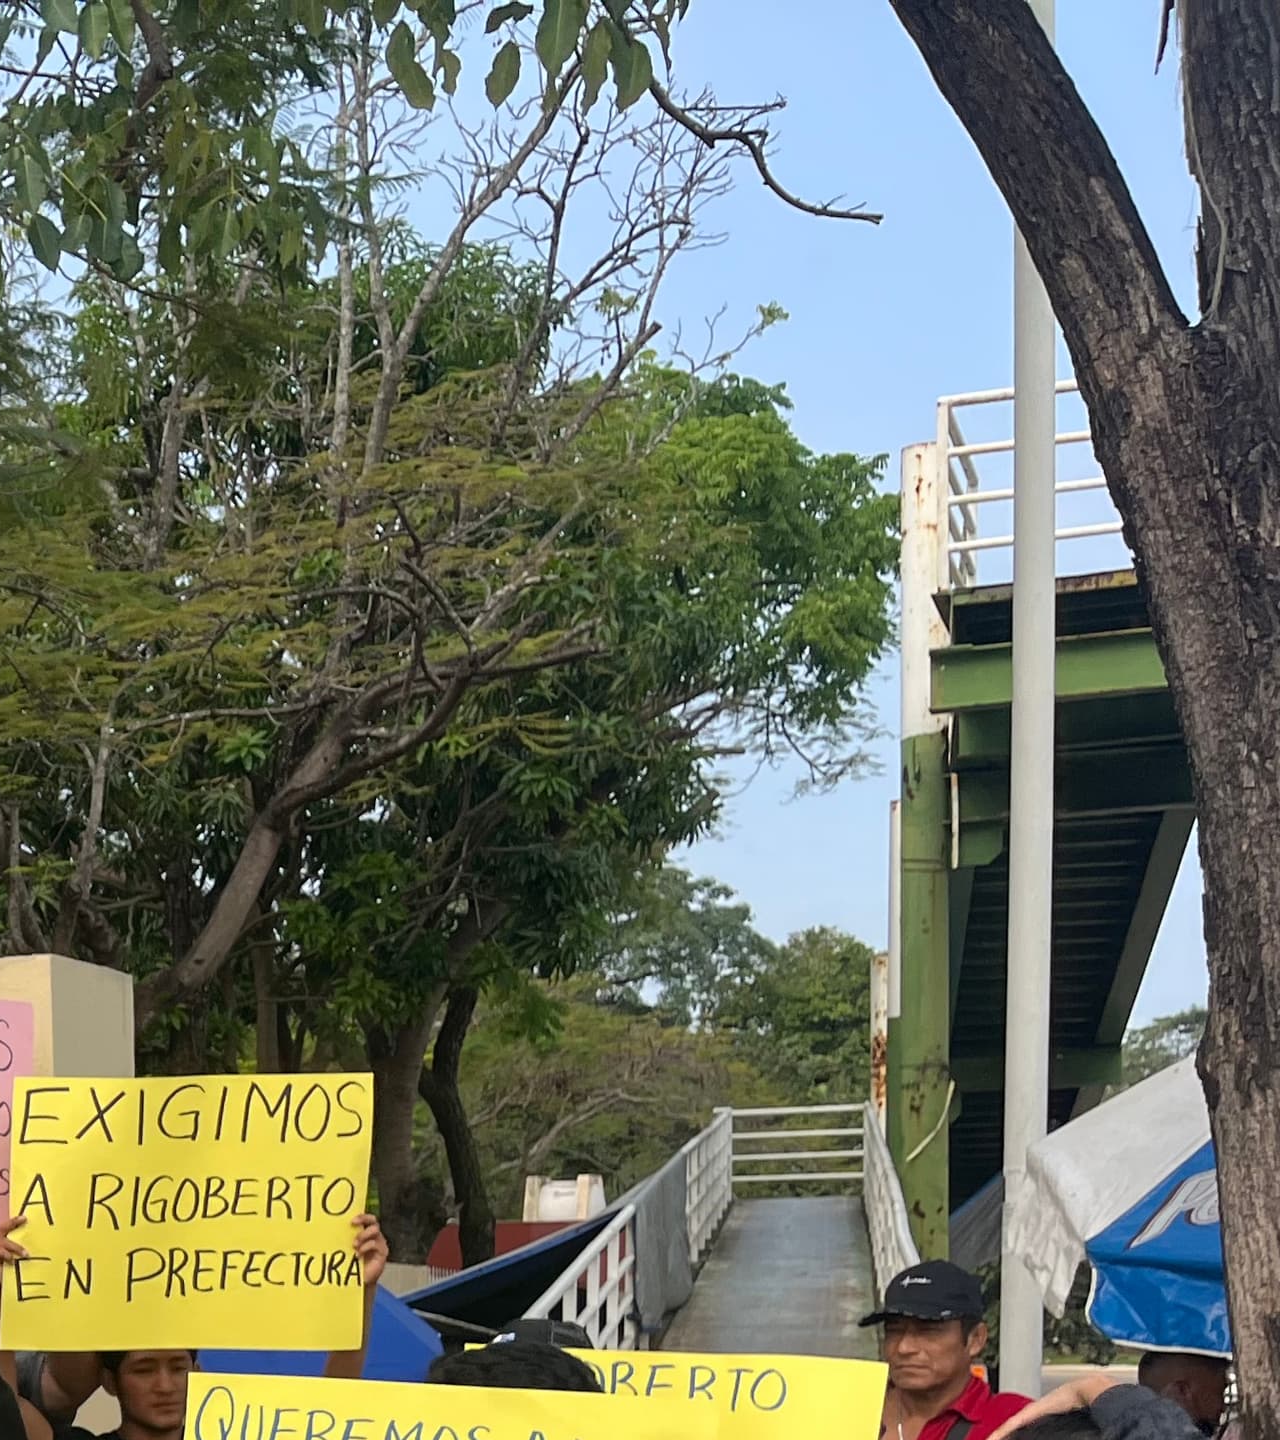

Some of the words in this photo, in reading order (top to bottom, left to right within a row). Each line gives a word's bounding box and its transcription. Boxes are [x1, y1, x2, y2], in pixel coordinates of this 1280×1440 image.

[18, 1081, 366, 1146] EXIGIMOS
[19, 1173, 54, 1226] A
[86, 1173, 356, 1231] RIGOBERTO
[14, 1256, 93, 1302] EN
[126, 1247, 362, 1303] PREFECTURA
